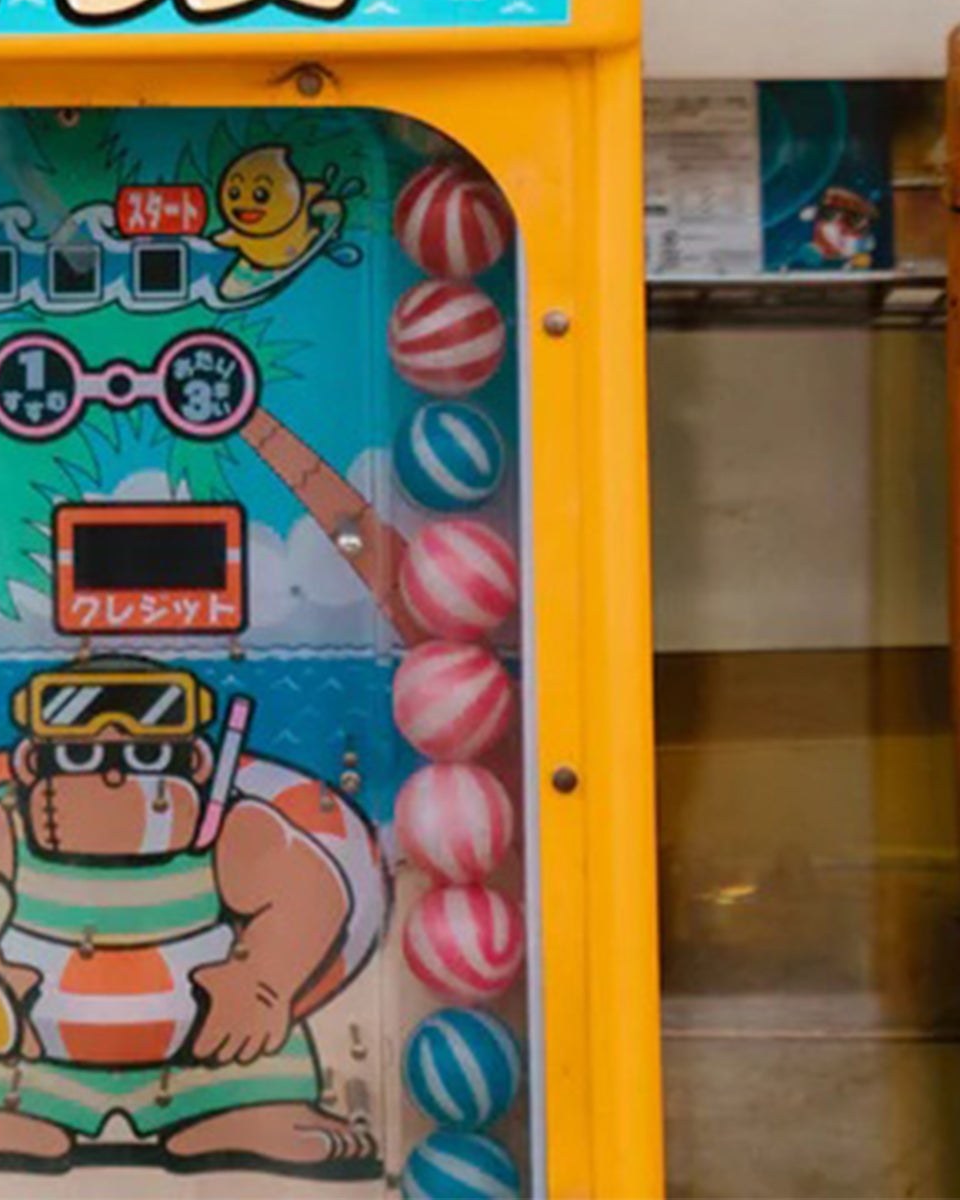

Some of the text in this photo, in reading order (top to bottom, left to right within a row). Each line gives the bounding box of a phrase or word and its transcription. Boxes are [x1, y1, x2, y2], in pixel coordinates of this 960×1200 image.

[124, 191, 200, 228] スタート
[70, 595, 236, 628] クレジット
